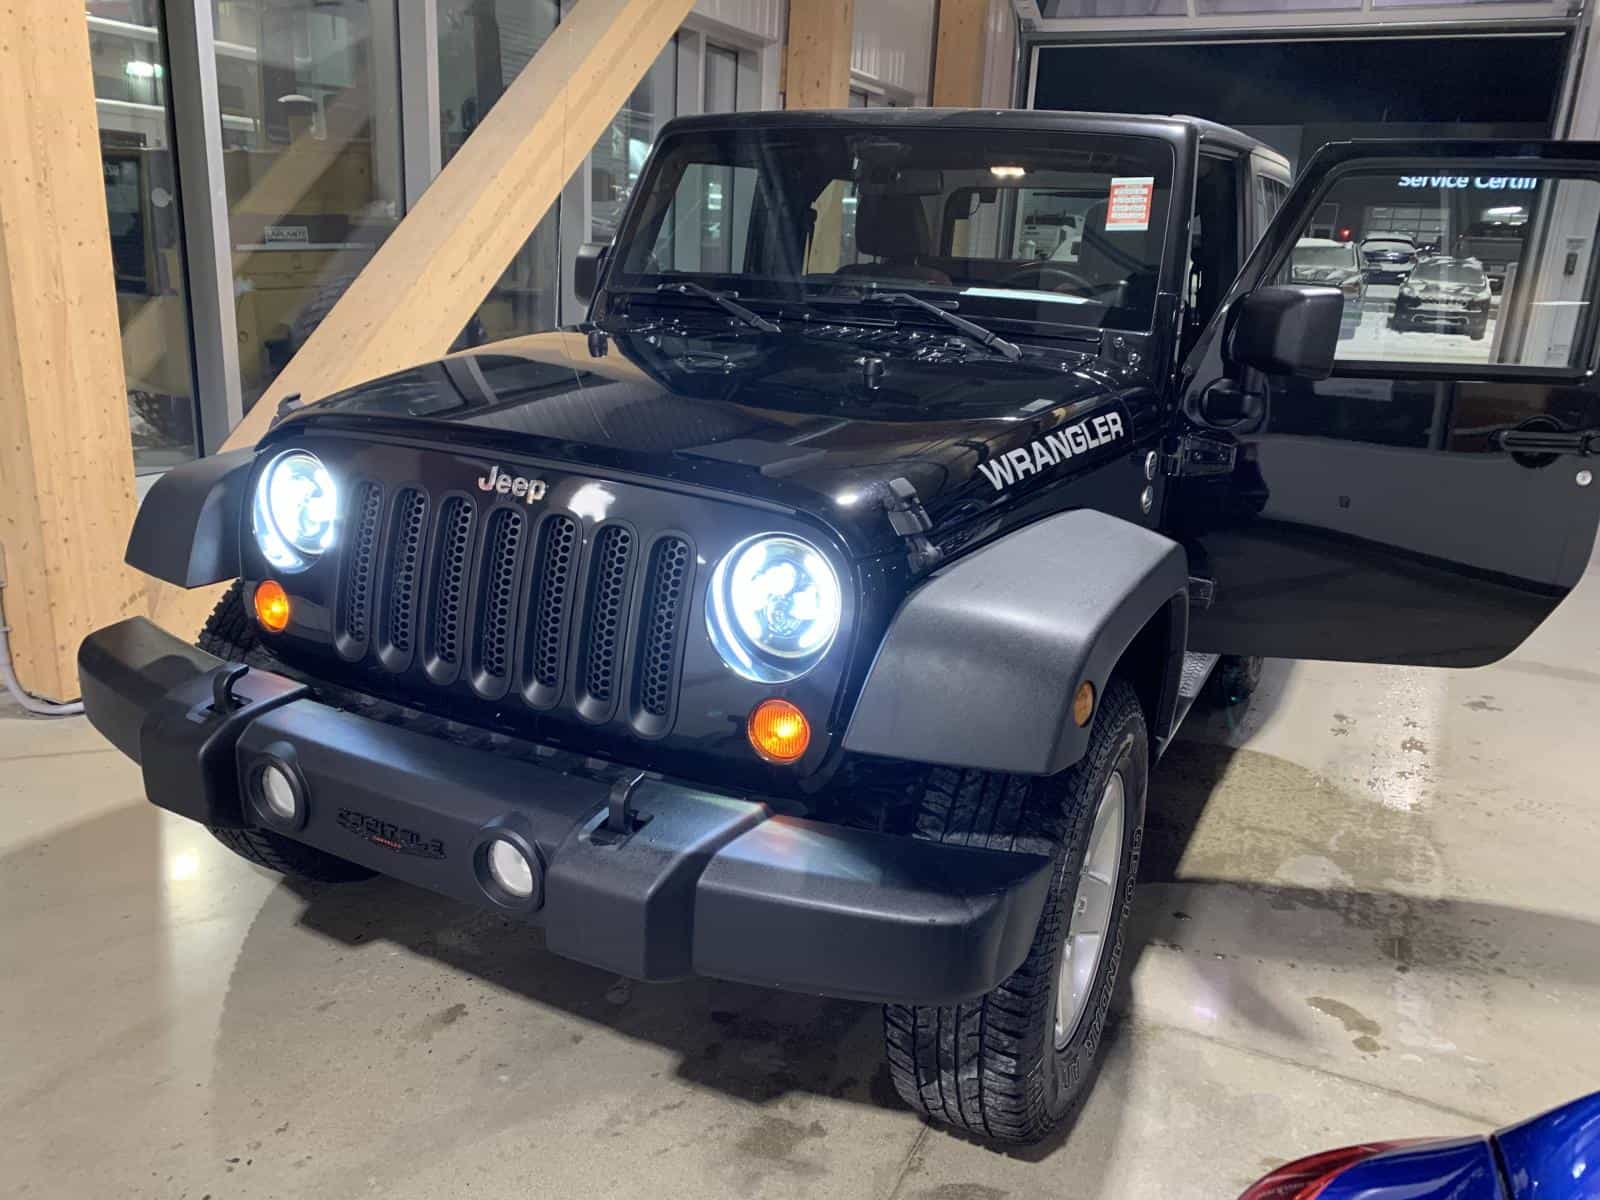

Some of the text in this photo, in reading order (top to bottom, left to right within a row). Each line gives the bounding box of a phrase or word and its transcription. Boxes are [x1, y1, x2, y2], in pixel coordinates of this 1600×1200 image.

[1397, 175, 1469, 189] Service
[977, 411, 1124, 491] WRANGLER
[478, 465, 546, 505] Jeep
